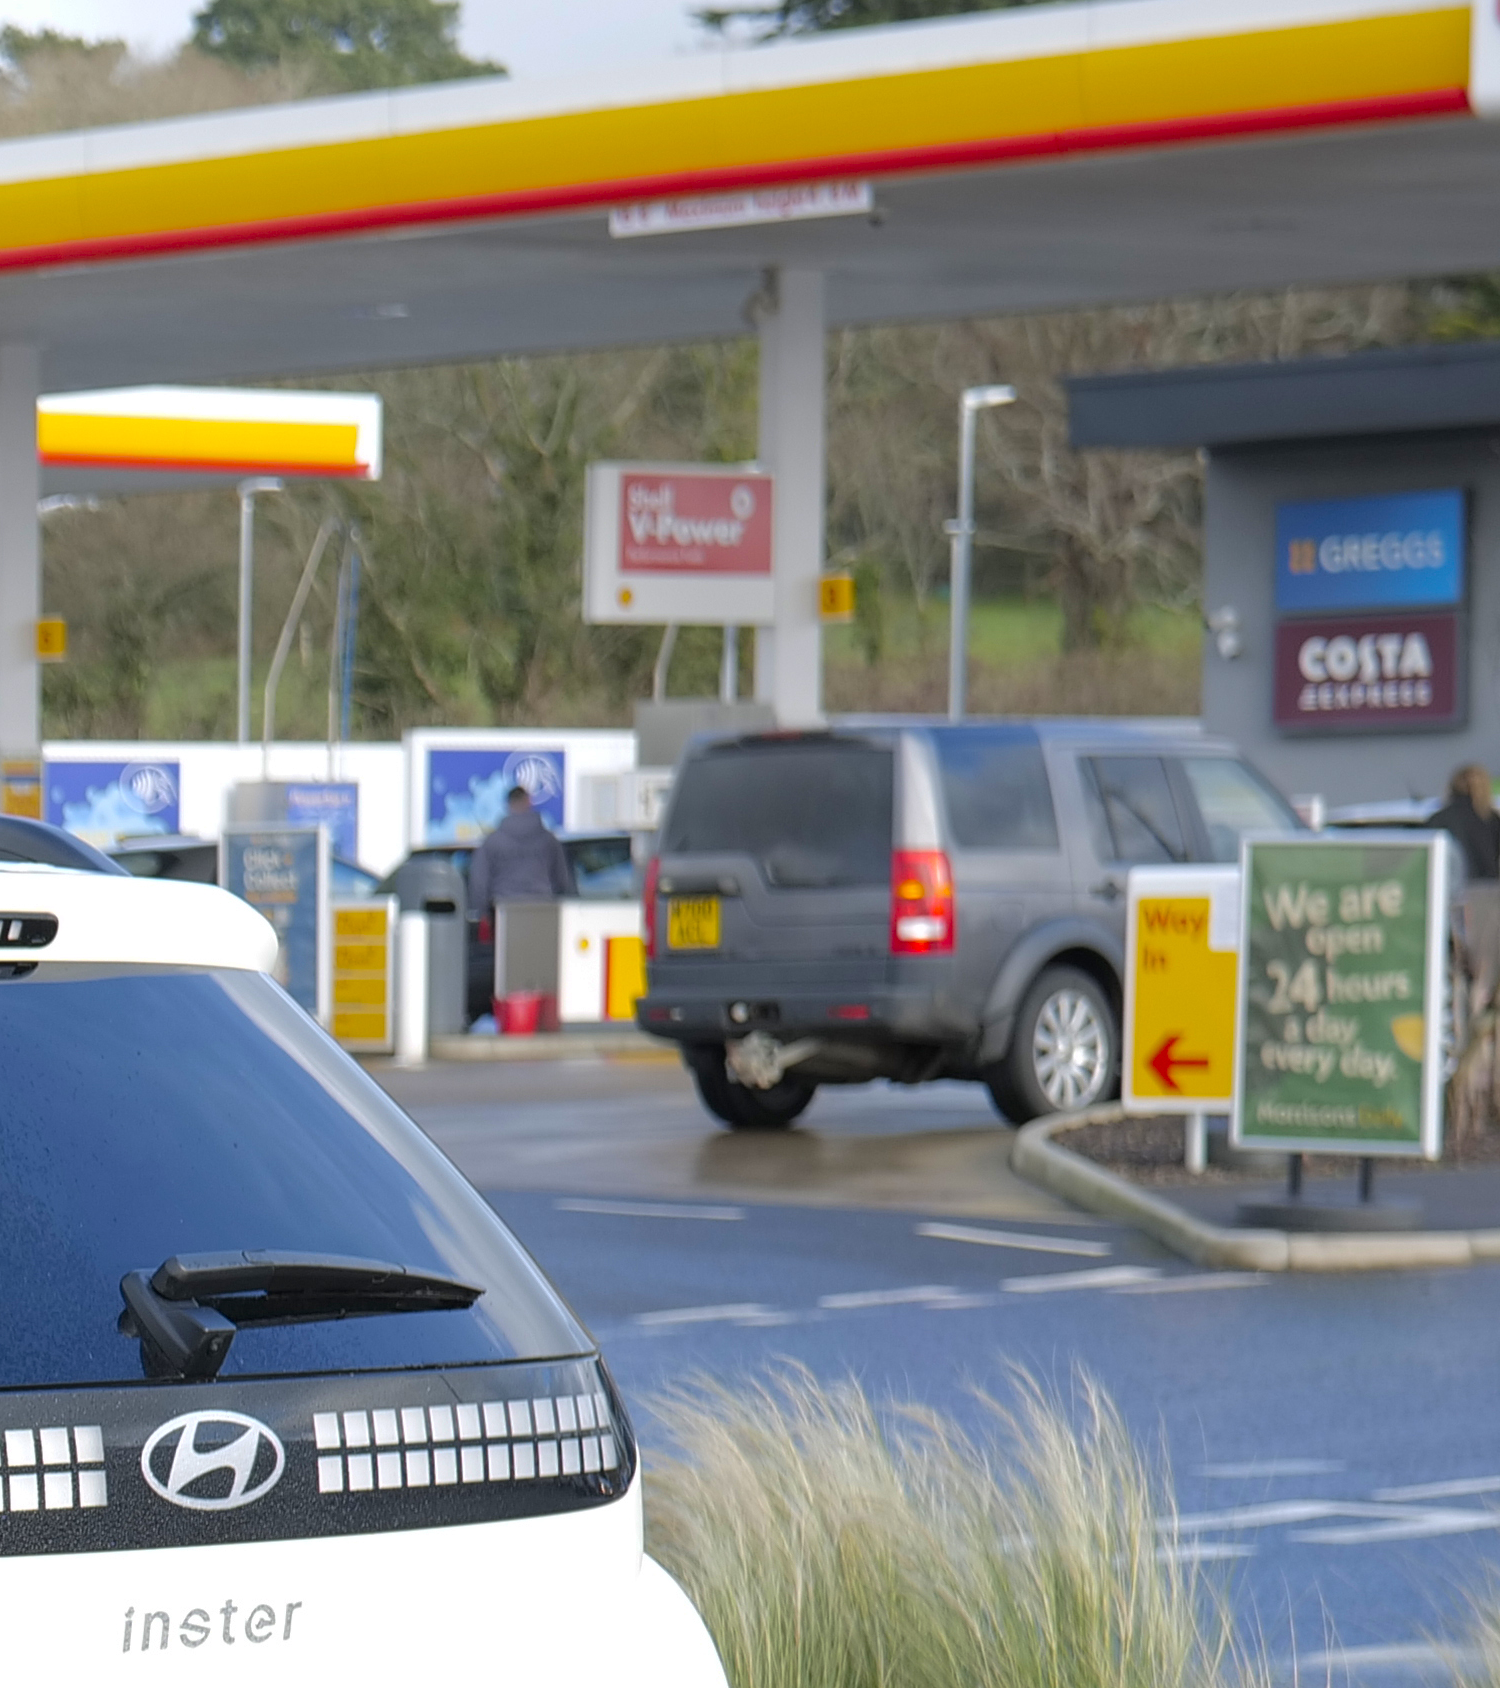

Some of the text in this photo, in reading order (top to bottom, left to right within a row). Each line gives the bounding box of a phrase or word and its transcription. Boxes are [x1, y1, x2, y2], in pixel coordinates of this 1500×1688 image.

[628, 512, 743, 546] V-Power
[1319, 529, 1444, 574] GREGGS
[1298, 632, 1433, 685] COSTA
[1143, 905, 1205, 936] Way
[1263, 880, 1404, 931] We are
[1143, 946, 1167, 970] In
[1305, 924, 1384, 963] open
[1266, 959, 1409, 1014] 24 hours
[1283, 1017, 1298, 1042] a
[1260, 1041, 1335, 1083] every
[122, 1599, 302, 1653] inster
